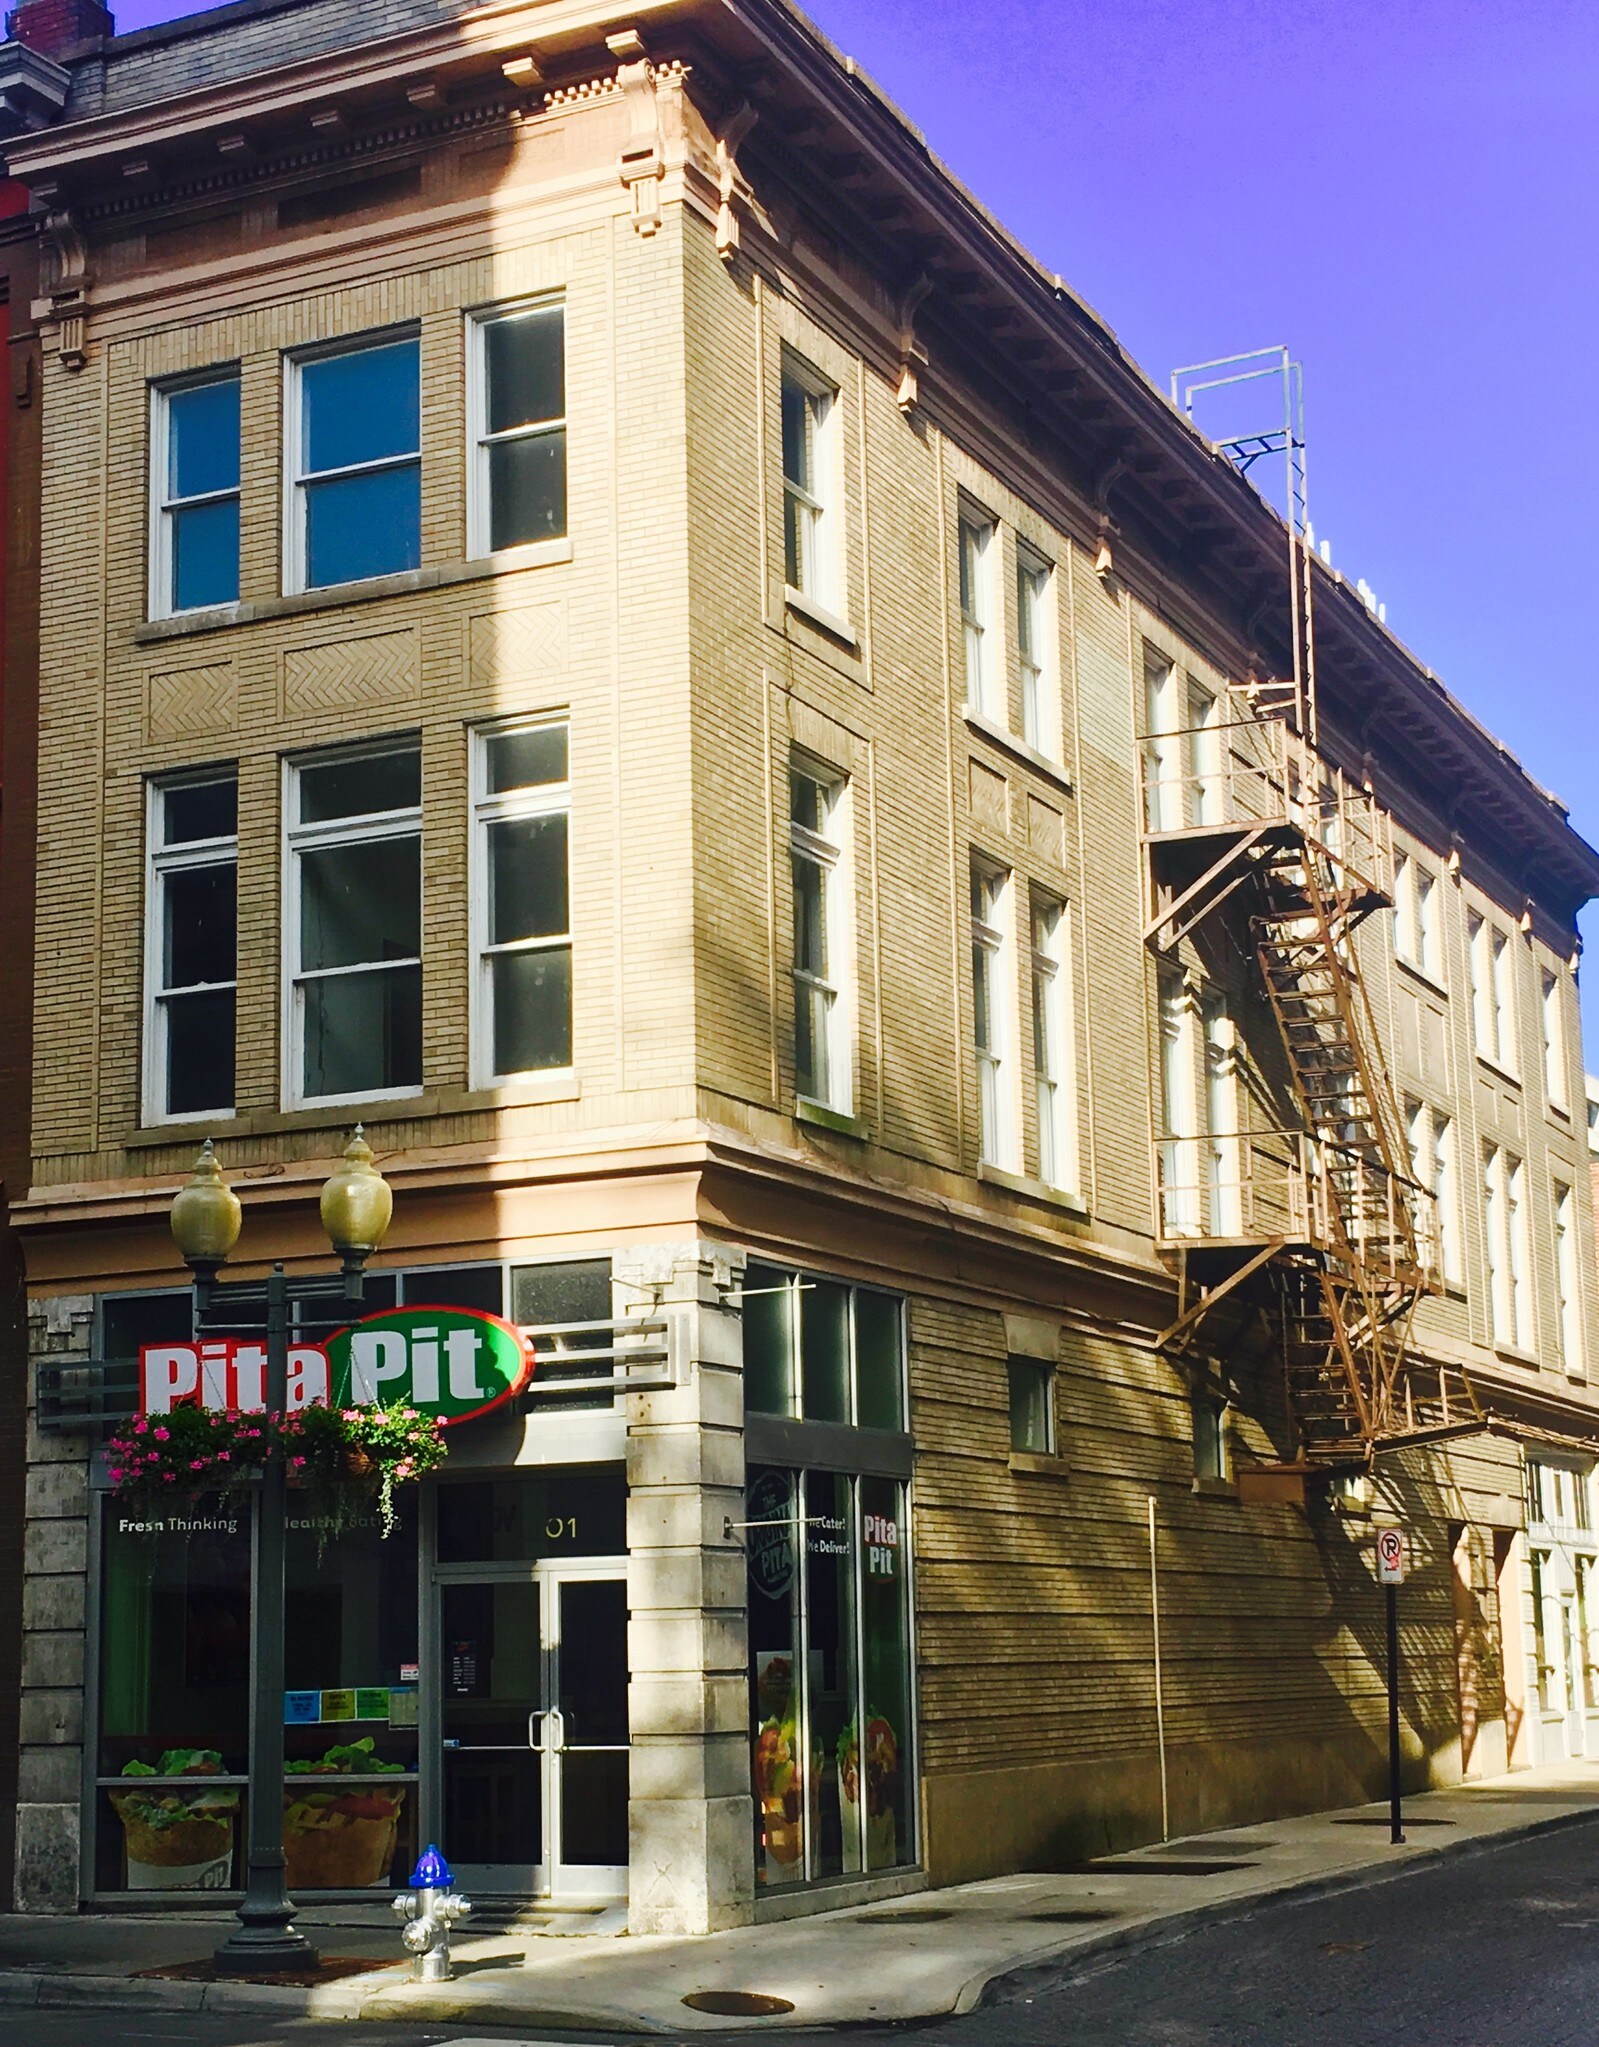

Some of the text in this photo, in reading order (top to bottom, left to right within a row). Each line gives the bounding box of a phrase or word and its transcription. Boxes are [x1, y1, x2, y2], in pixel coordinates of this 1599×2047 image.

[144, 1326, 485, 1415] Pita Pit
[168, 1516, 238, 1534] Thinking
[821, 1515, 846, 1531] Cater!
[863, 1514, 898, 1546] Pita
[819, 1539, 850, 1555] Deliver!
[869, 1545, 894, 1575] Pit
